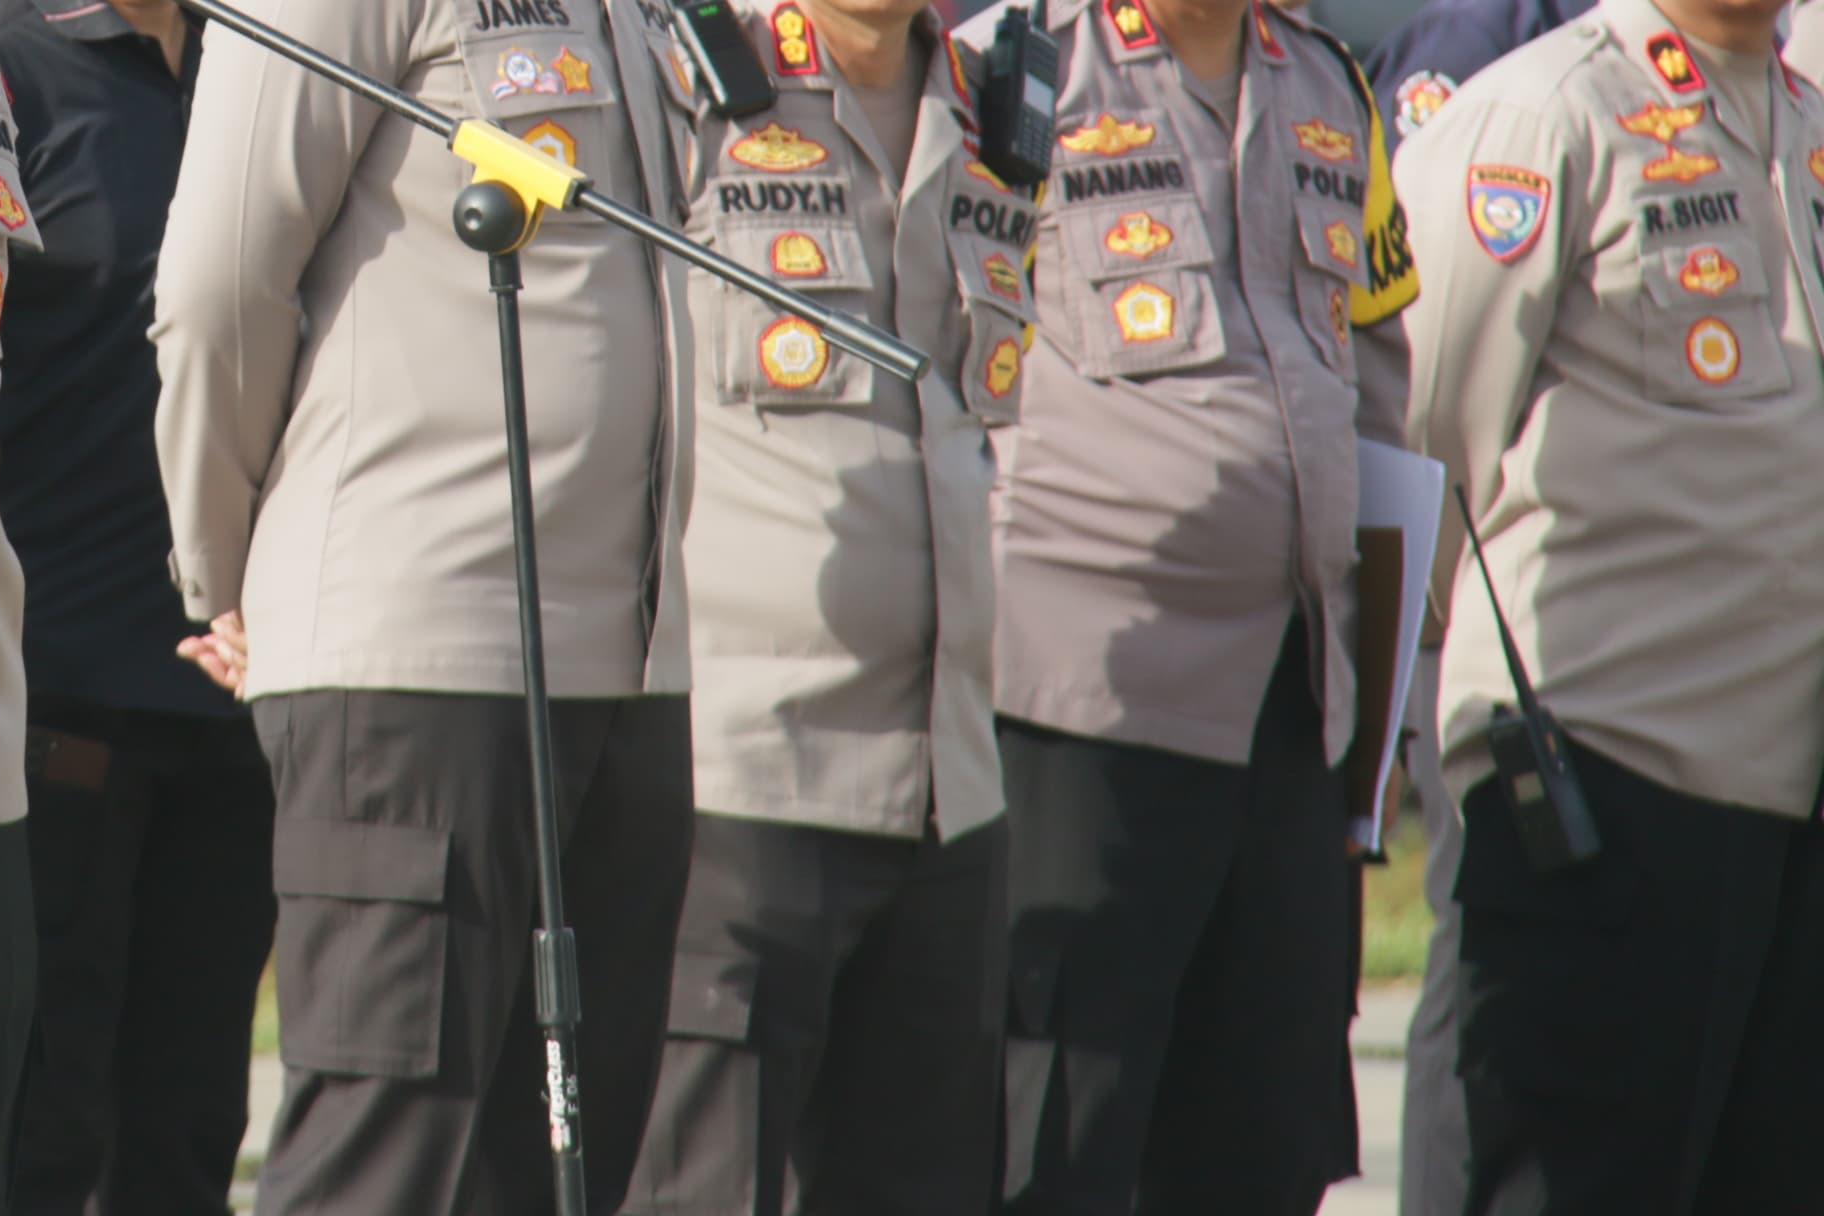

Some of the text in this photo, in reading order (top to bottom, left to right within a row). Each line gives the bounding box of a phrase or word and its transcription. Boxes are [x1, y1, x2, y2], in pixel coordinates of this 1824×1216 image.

[719, 183, 846, 214] RUDY.H
[1061, 160, 1184, 201] NANANG
[950, 197, 1034, 244] POLRI
[1642, 191, 1742, 235] R.SIGIT
